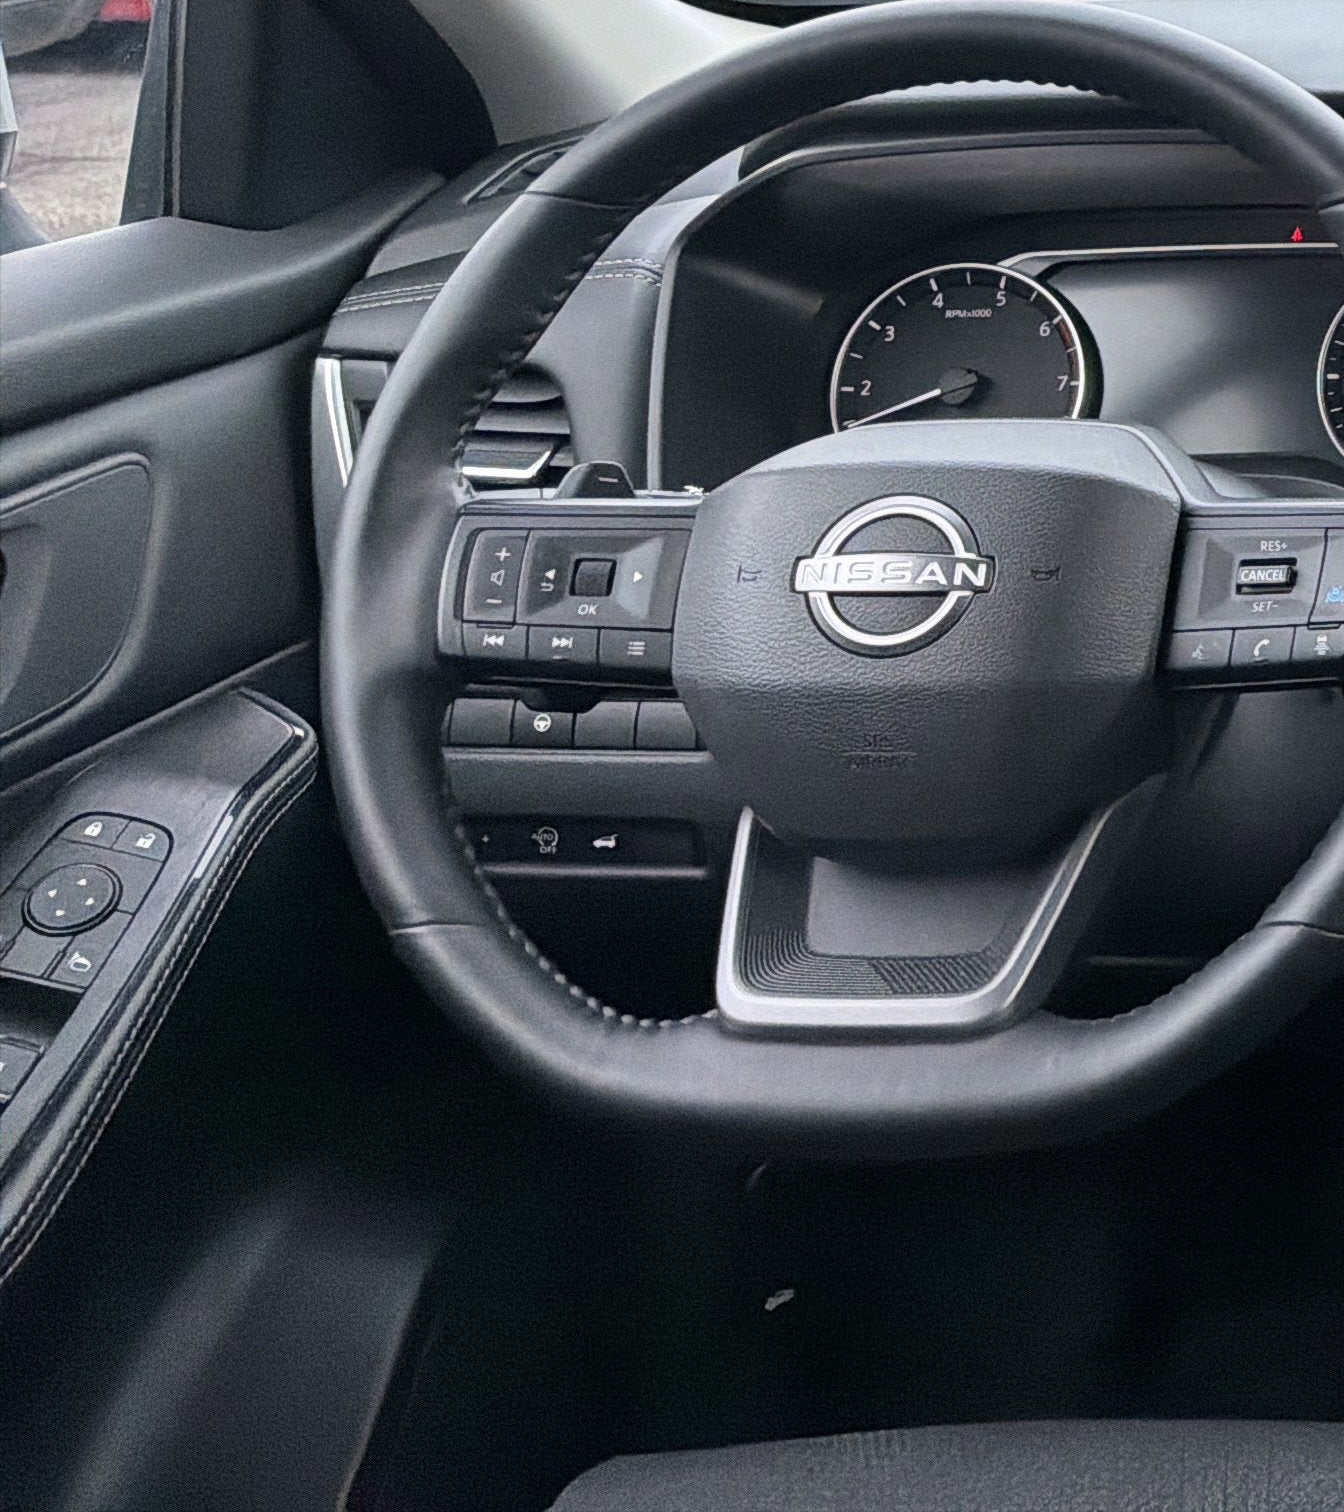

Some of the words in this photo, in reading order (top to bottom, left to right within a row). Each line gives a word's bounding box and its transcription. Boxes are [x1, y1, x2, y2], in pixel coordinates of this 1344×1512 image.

[931, 293, 944, 308] 4
[996, 291, 1007, 306] 5
[884, 326, 896, 341] 3
[1039, 321, 1050, 336] 6
[860, 381, 871, 396] 2
[1057, 375, 1068, 391] 7
[1260, 541, 1287, 552] RES+
[800, 560, 987, 587] NISSAN
[1240, 569, 1286, 581] CANCEL
[577, 604, 598, 615] OK
